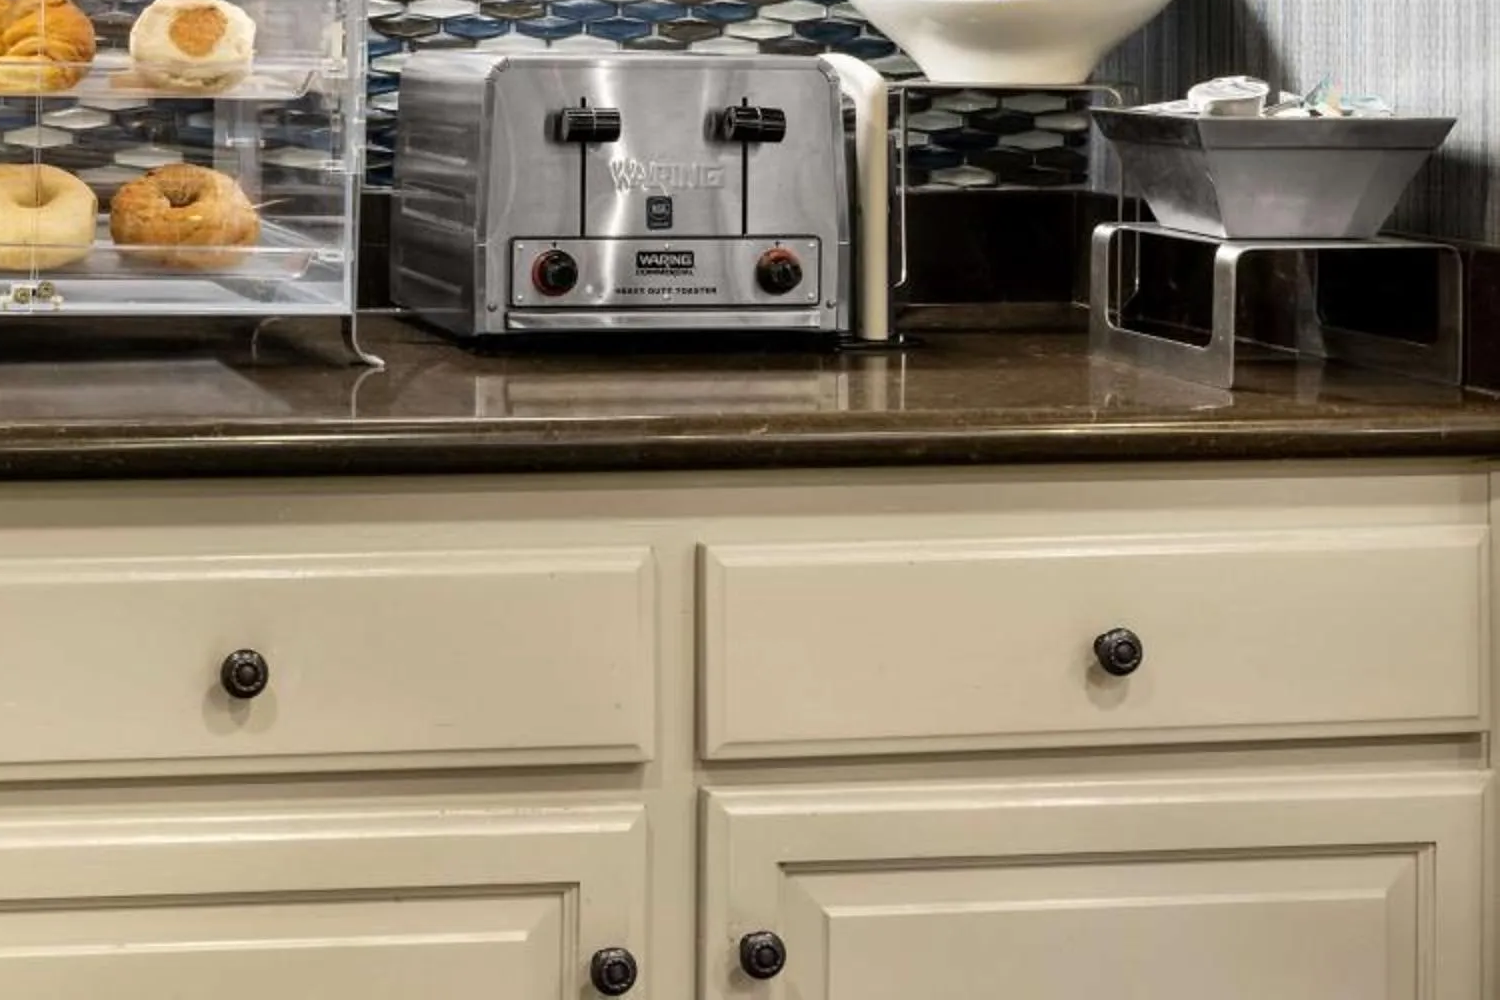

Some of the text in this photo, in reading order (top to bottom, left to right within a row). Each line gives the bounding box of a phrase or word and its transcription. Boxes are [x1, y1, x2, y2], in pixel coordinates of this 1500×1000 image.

[609, 158, 724, 193] WARING
[639, 253, 693, 266] WARING
[674, 286, 717, 295] TOASTER
